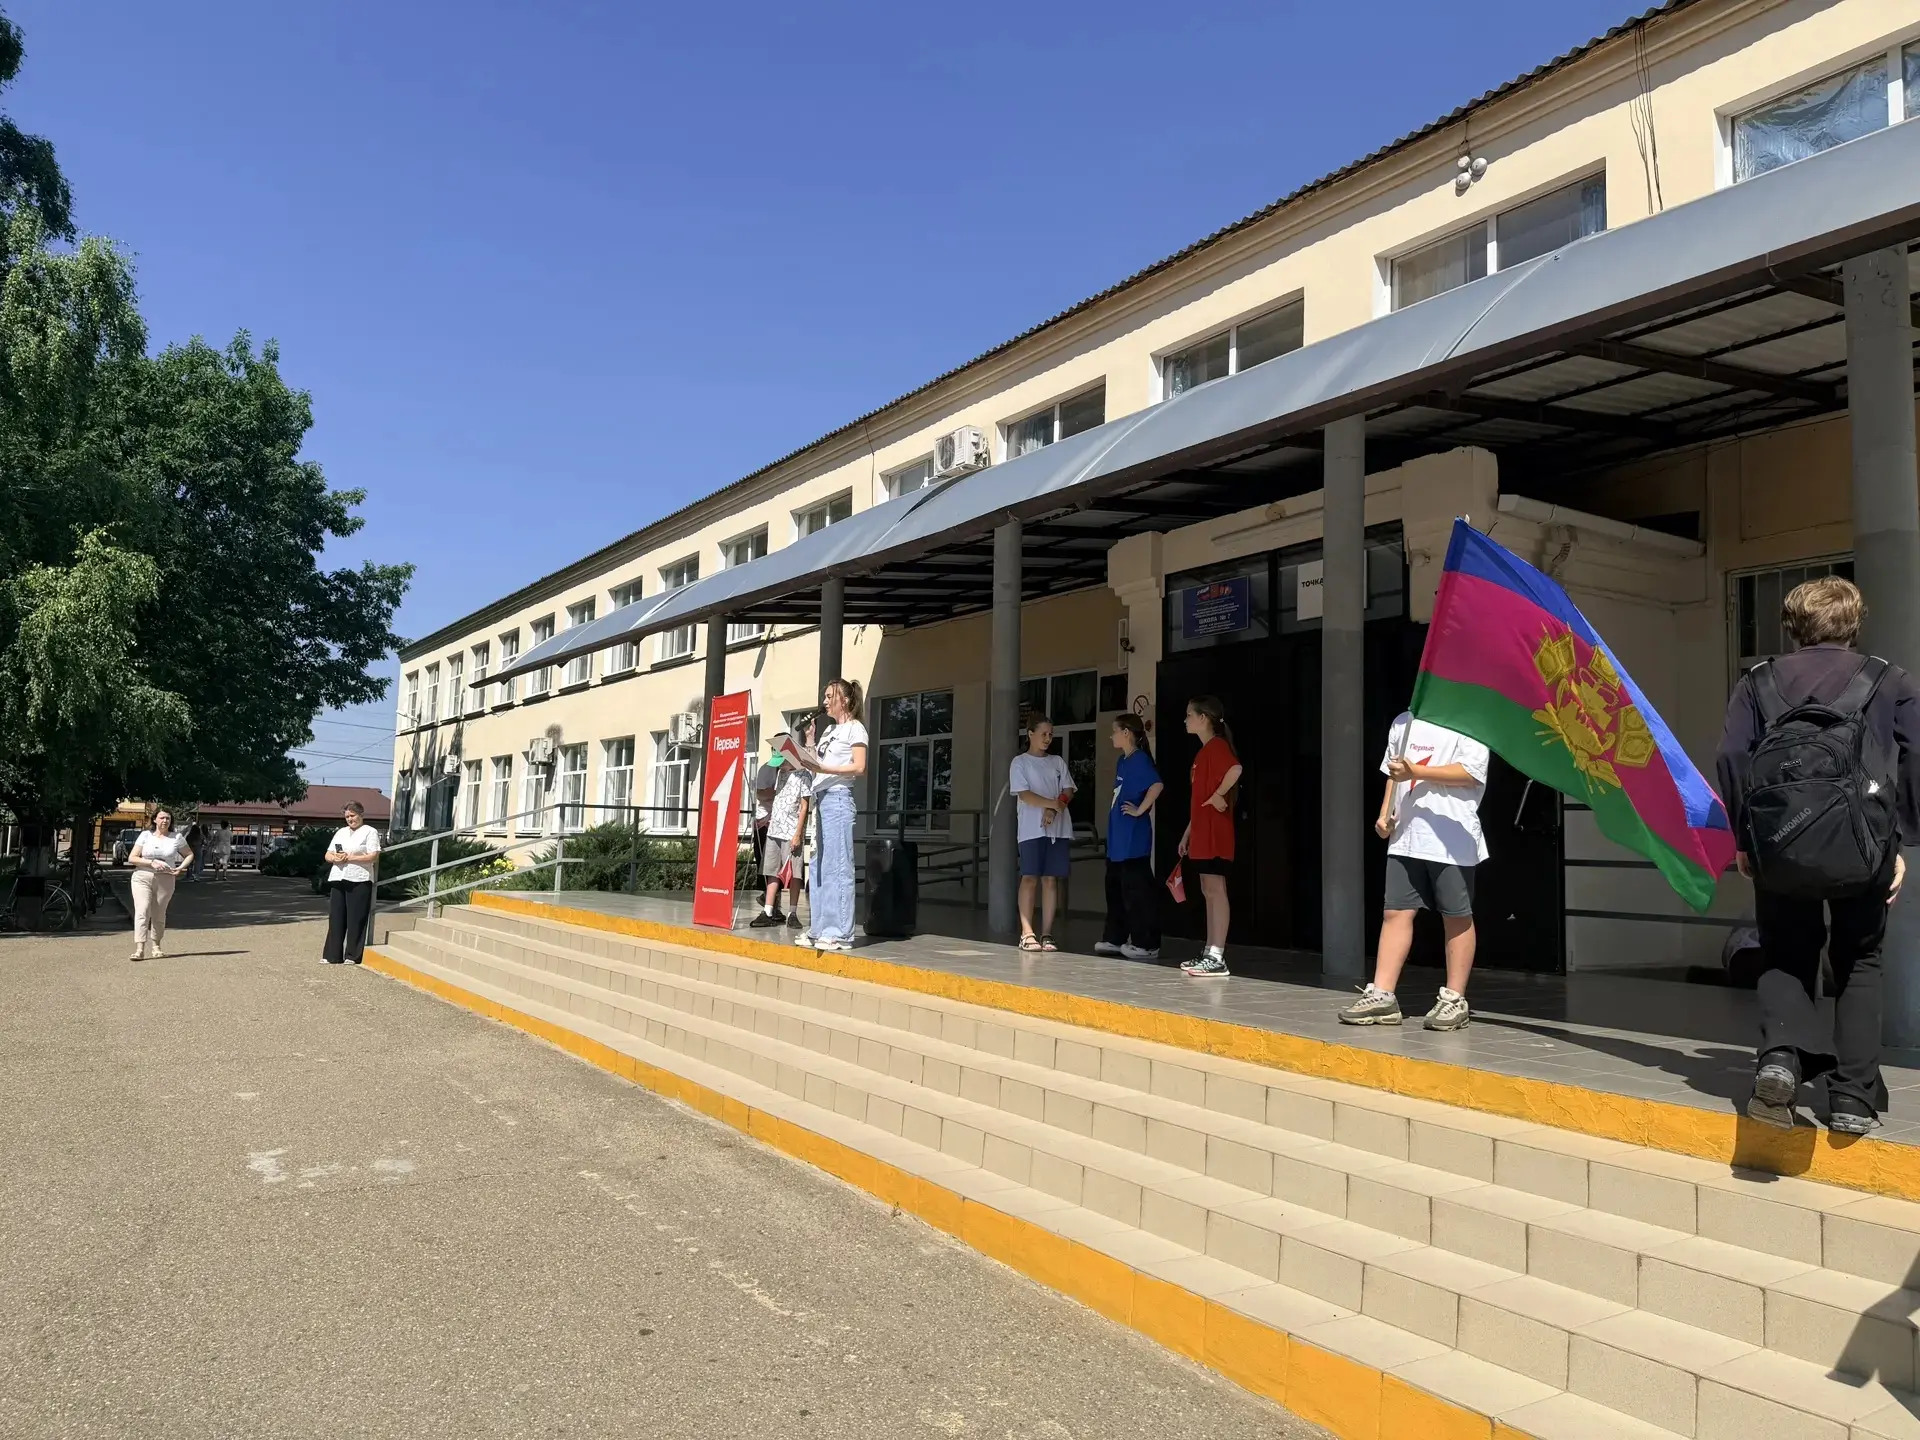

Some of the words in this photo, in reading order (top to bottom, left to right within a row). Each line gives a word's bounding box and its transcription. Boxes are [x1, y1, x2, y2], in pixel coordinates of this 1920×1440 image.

[1199, 616, 1218, 624] ШКОЛА
[714, 736, 740, 755] Первые
[1409, 743, 1435, 752] Первые
